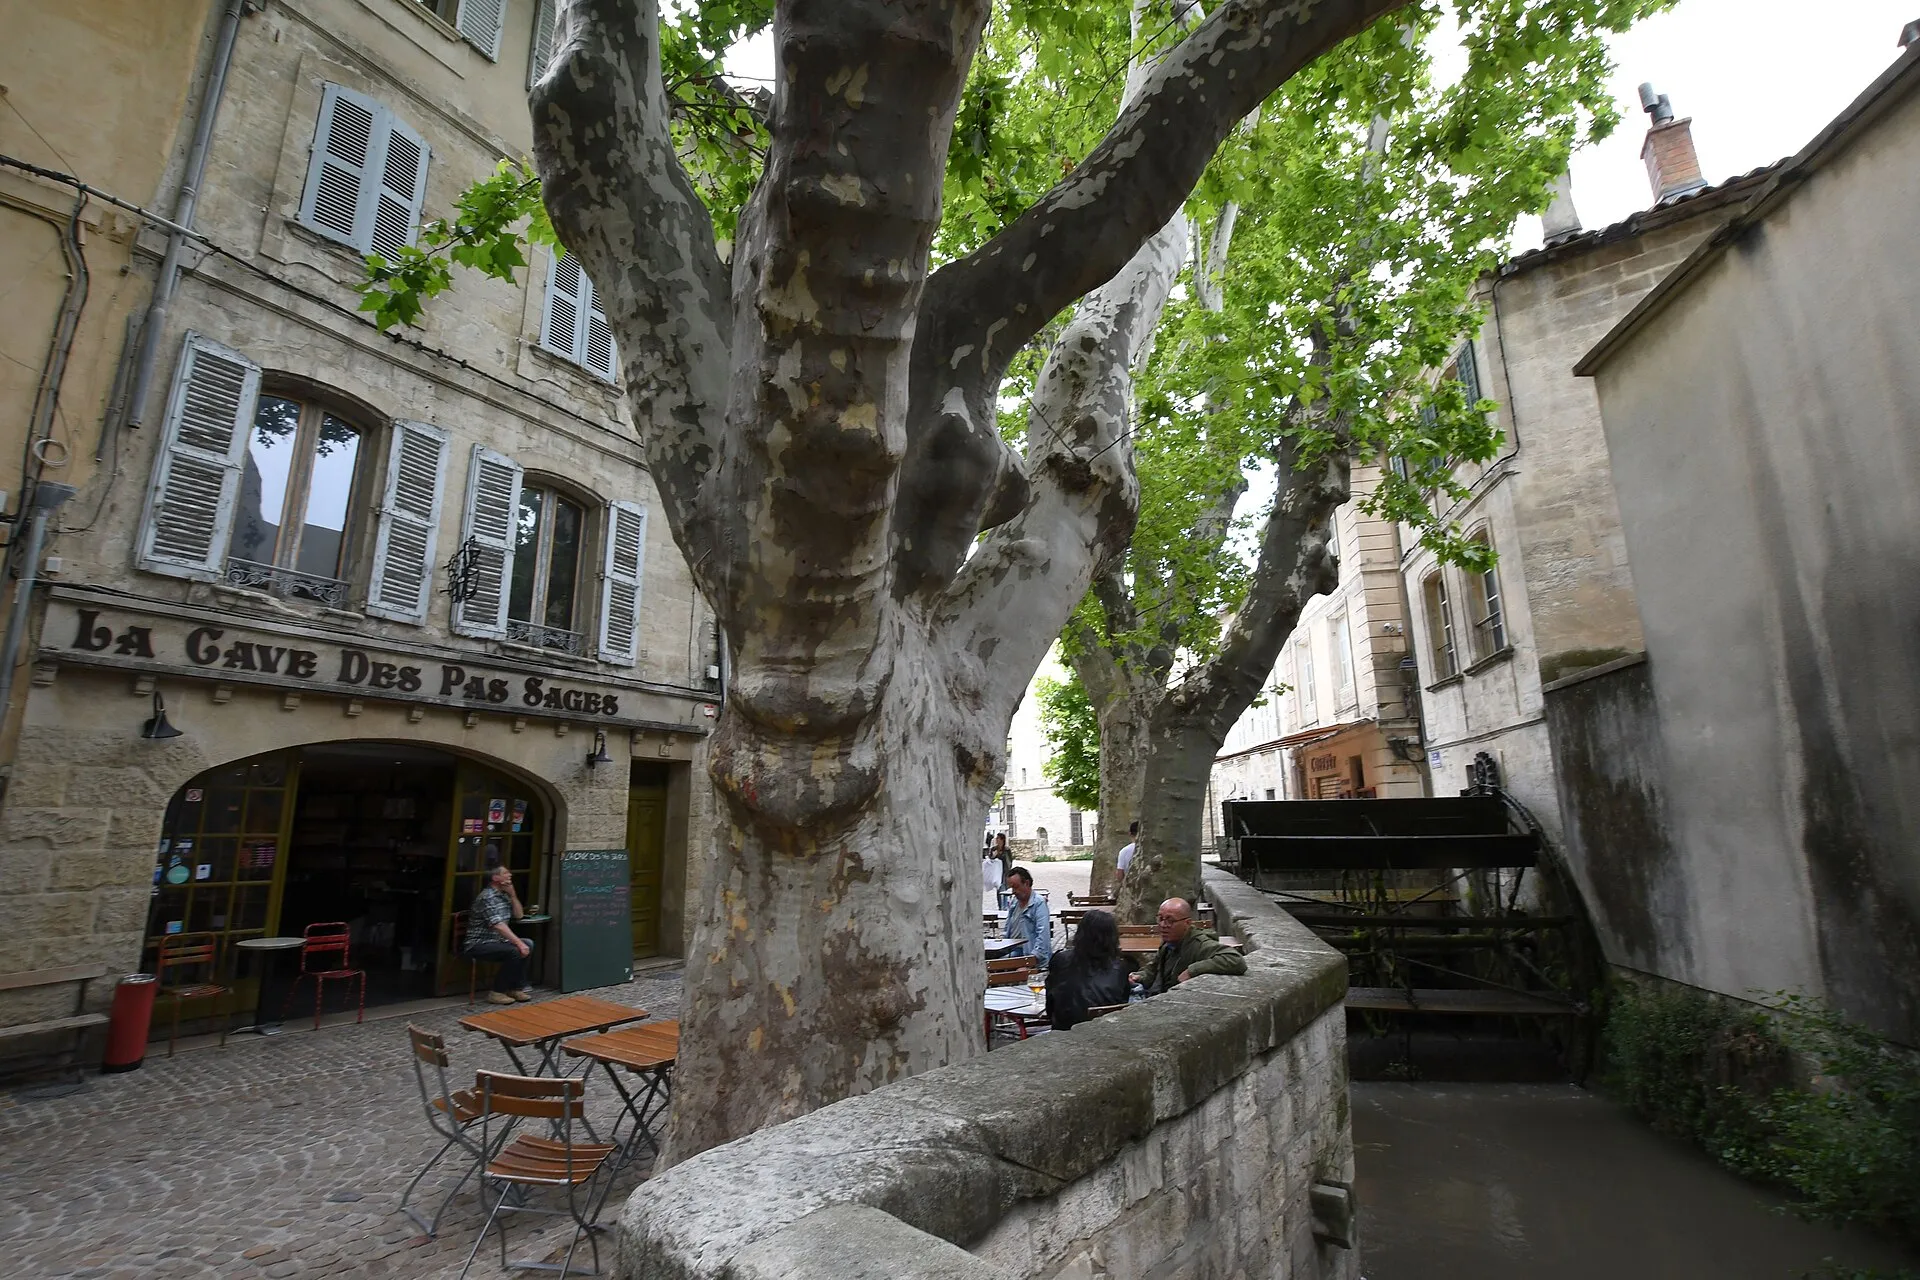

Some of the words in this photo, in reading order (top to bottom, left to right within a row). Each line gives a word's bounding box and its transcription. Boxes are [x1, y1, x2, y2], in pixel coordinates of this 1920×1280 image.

[72, 608, 155, 658] LA
[185, 626, 318, 678] CAVE
[337, 649, 422, 692] DES
[439, 664, 509, 703] PAS
[523, 677, 619, 715] SAGES
